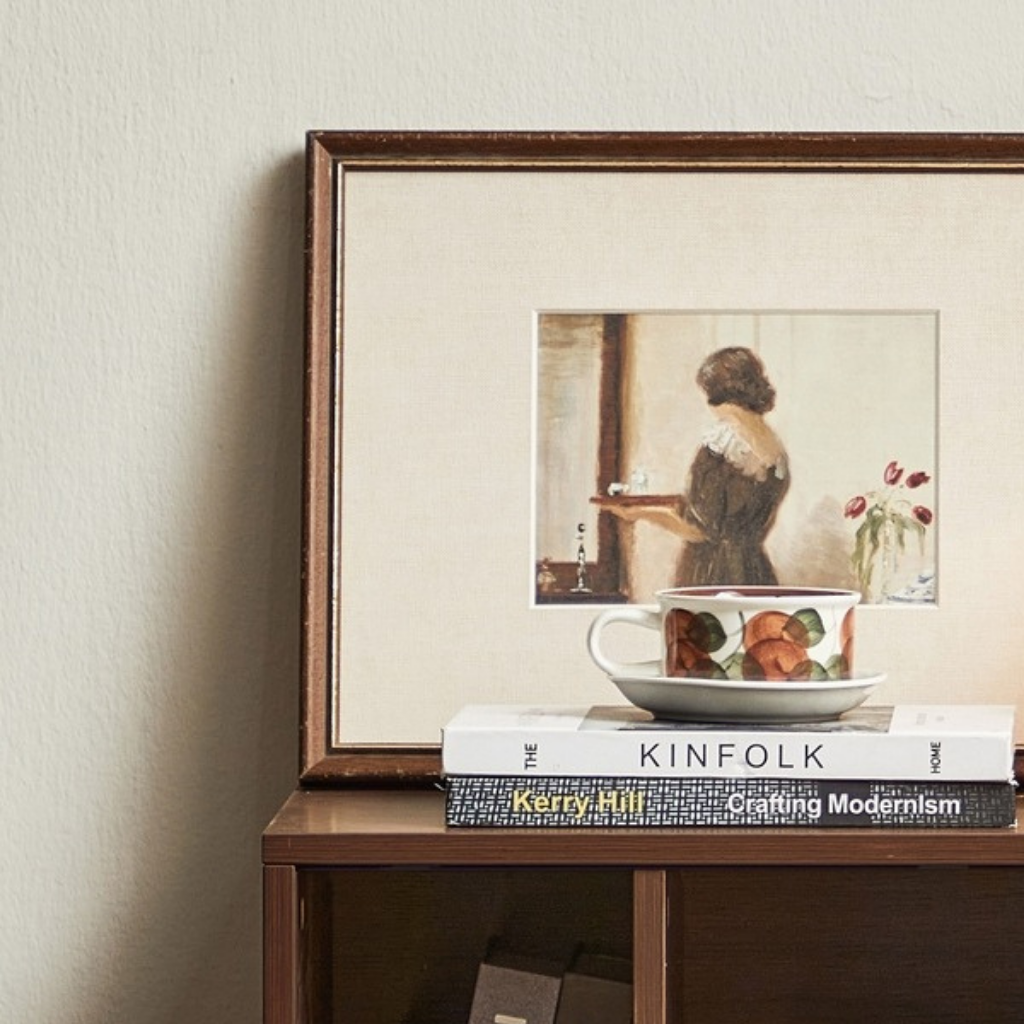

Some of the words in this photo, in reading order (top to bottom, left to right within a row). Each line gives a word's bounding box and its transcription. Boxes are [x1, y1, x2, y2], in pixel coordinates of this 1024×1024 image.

[524, 743, 538, 770] THE
[640, 743, 825, 769] KINFOLK
[930, 741, 941, 774] HOME
[513, 790, 589, 818] Kerry
[599, 790, 644, 814] Hill
[727, 793, 821, 818] Crafting
